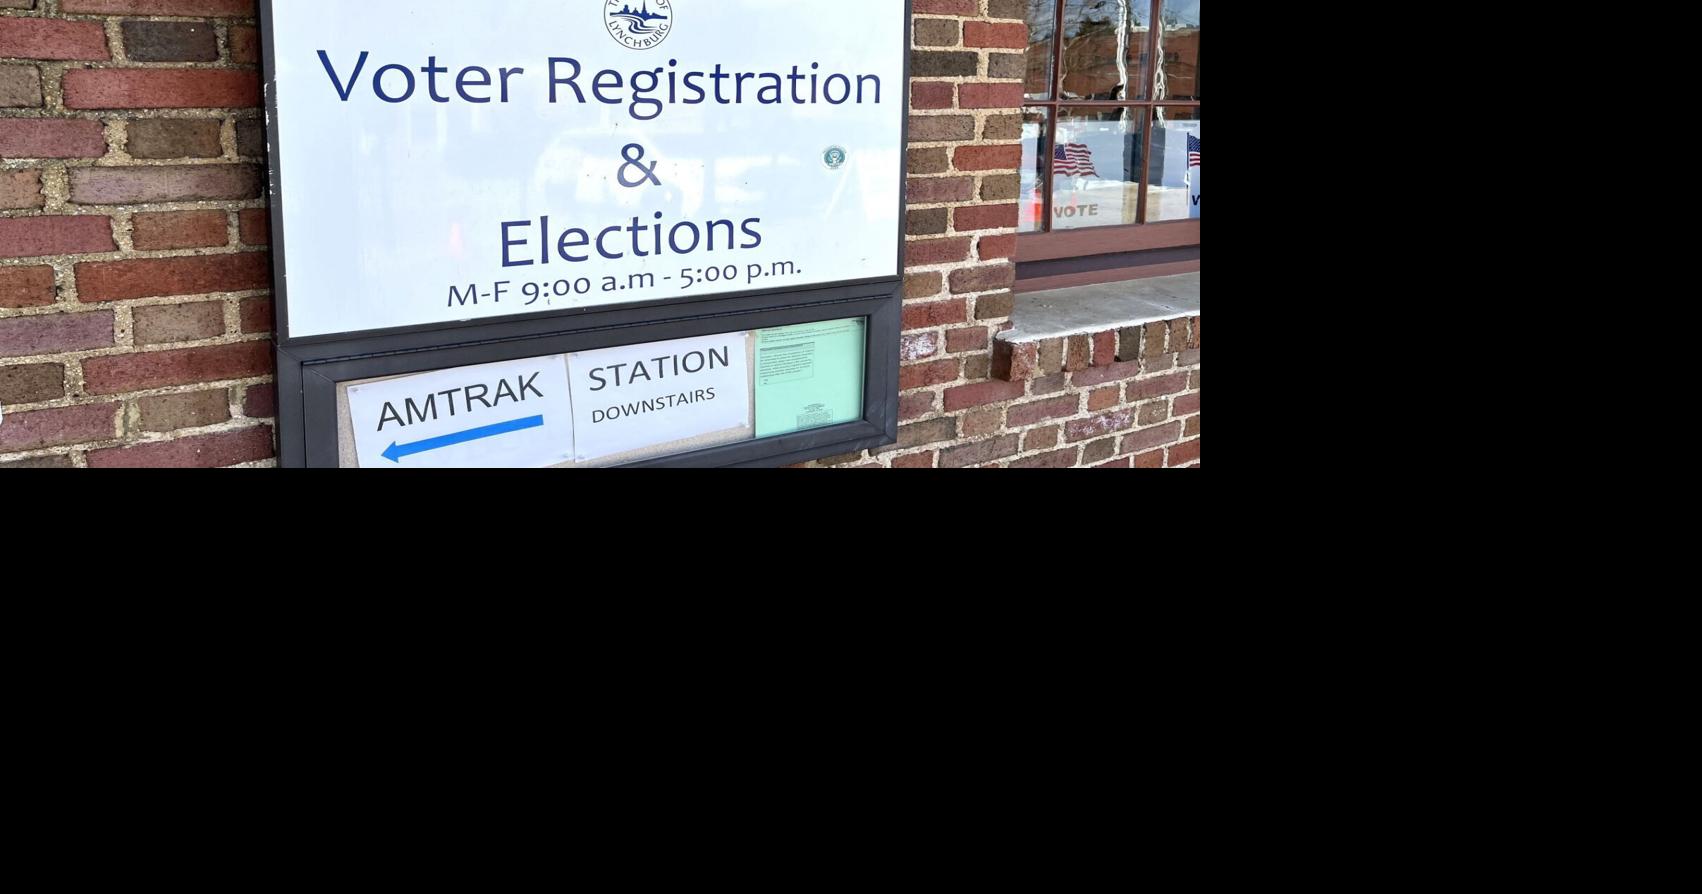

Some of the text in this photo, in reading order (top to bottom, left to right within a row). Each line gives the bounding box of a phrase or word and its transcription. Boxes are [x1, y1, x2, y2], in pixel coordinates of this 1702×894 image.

[609, 20, 669, 48] LYNCHBURG
[316, 49, 881, 120] Voter Registration
[617, 143, 662, 187] &
[1053, 203, 1098, 219] VOTE
[501, 211, 762, 268] Elections
[447, 280, 510, 307] M-F
[522, 277, 591, 304] 9:00
[602, 272, 655, 292] a.m
[680, 264, 737, 287] 5:00
[746, 260, 802, 284] p.m.
[588, 346, 730, 392] STATION
[377, 372, 544, 431] AMTRAK
[592, 387, 715, 423] DOWNSTAIRS
